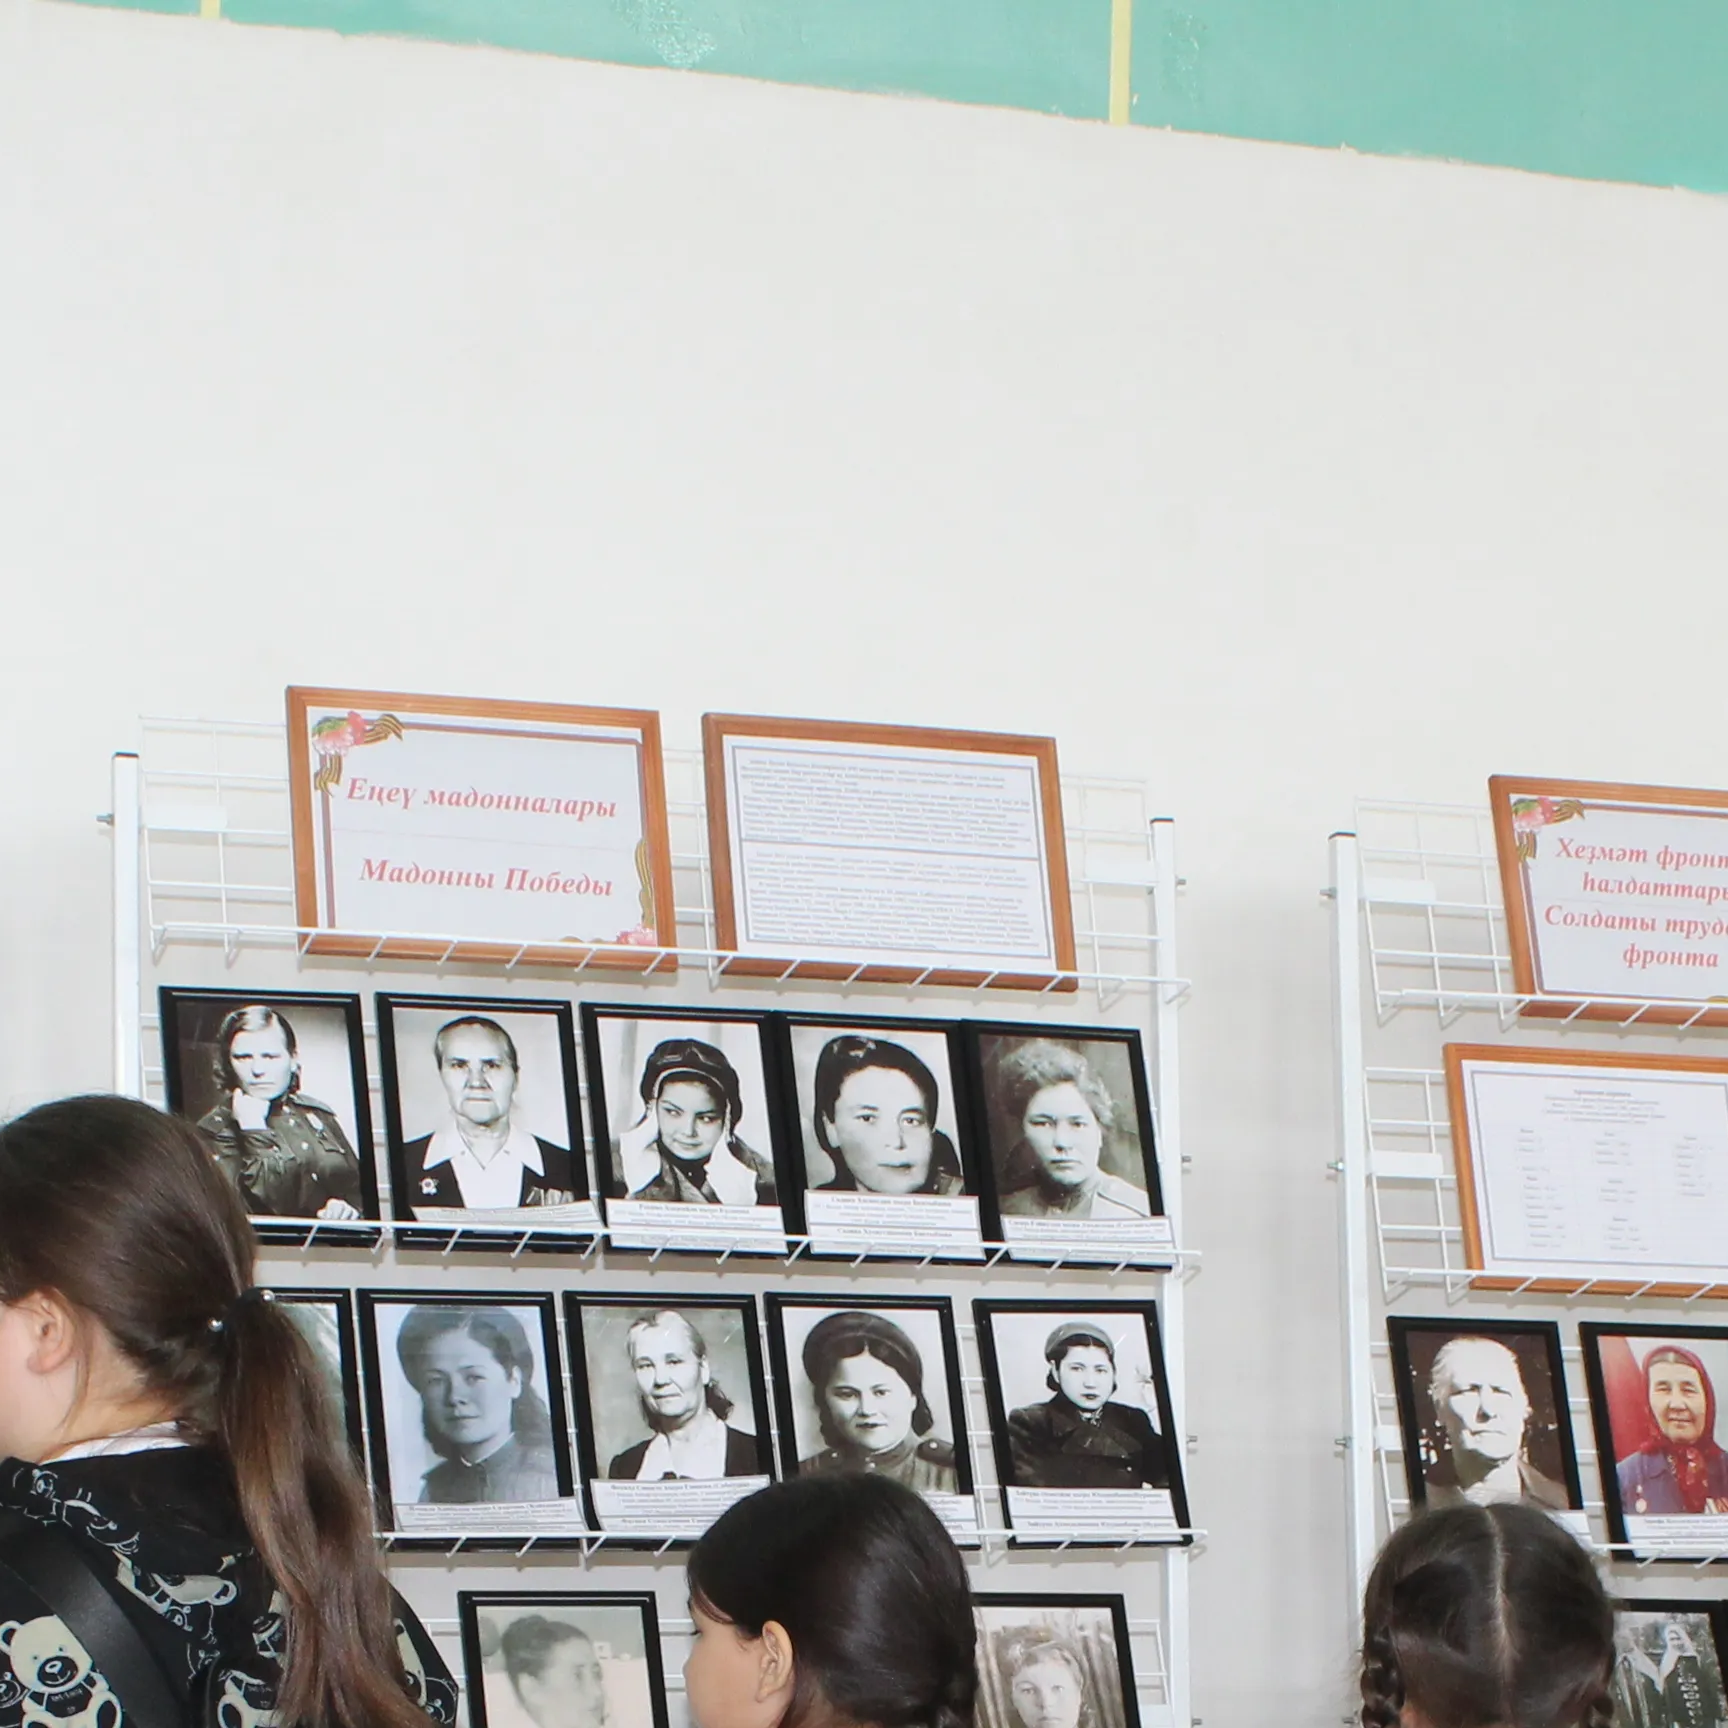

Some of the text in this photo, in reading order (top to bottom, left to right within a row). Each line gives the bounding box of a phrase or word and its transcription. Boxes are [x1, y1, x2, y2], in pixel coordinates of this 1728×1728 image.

[423, 786, 617, 821] мадонналары
[360, 858, 613, 896] Мадонны Победы
[1544, 905, 1657, 931] Солдаты
[1623, 943, 1720, 970] фронта
